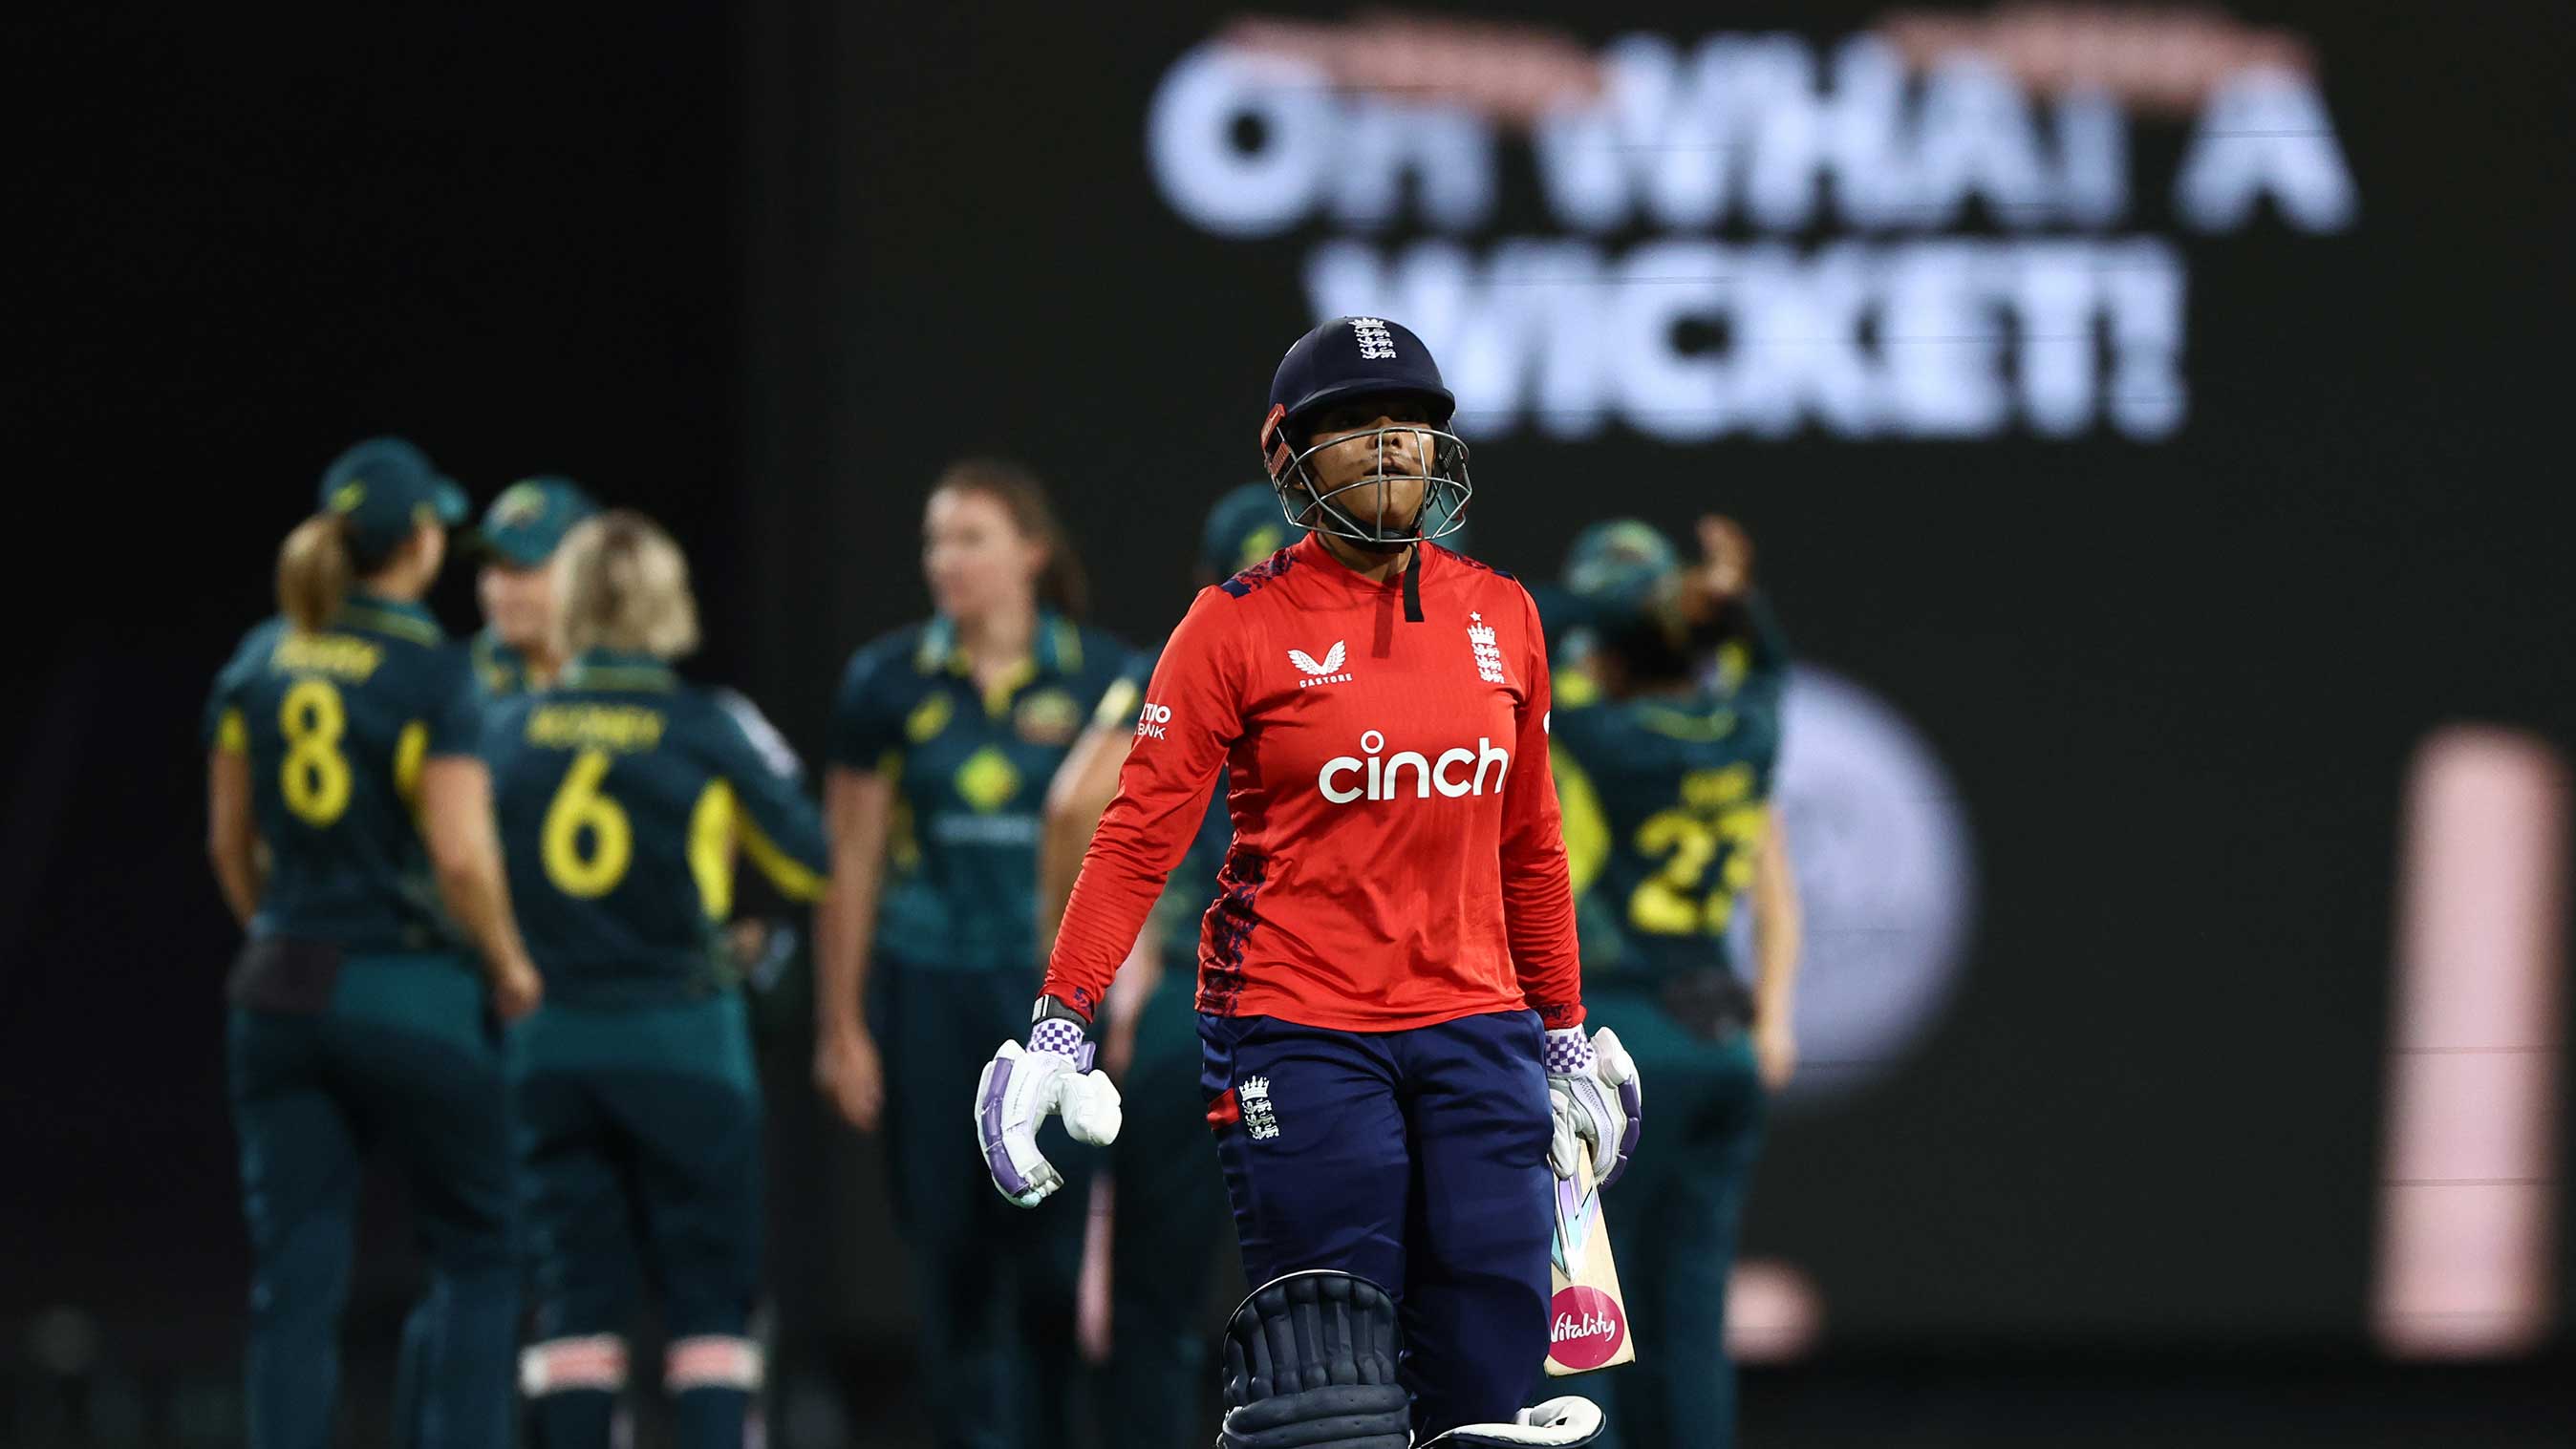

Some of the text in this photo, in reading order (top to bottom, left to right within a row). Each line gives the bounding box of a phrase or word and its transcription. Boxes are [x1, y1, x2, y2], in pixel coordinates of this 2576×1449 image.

[2173, 63, 2358, 234] A
[278, 677, 353, 827] 8
[1299, 673, 1353, 688] CASTORE
[539, 747, 633, 900] 6
[1318, 730, 1510, 804] cinch
